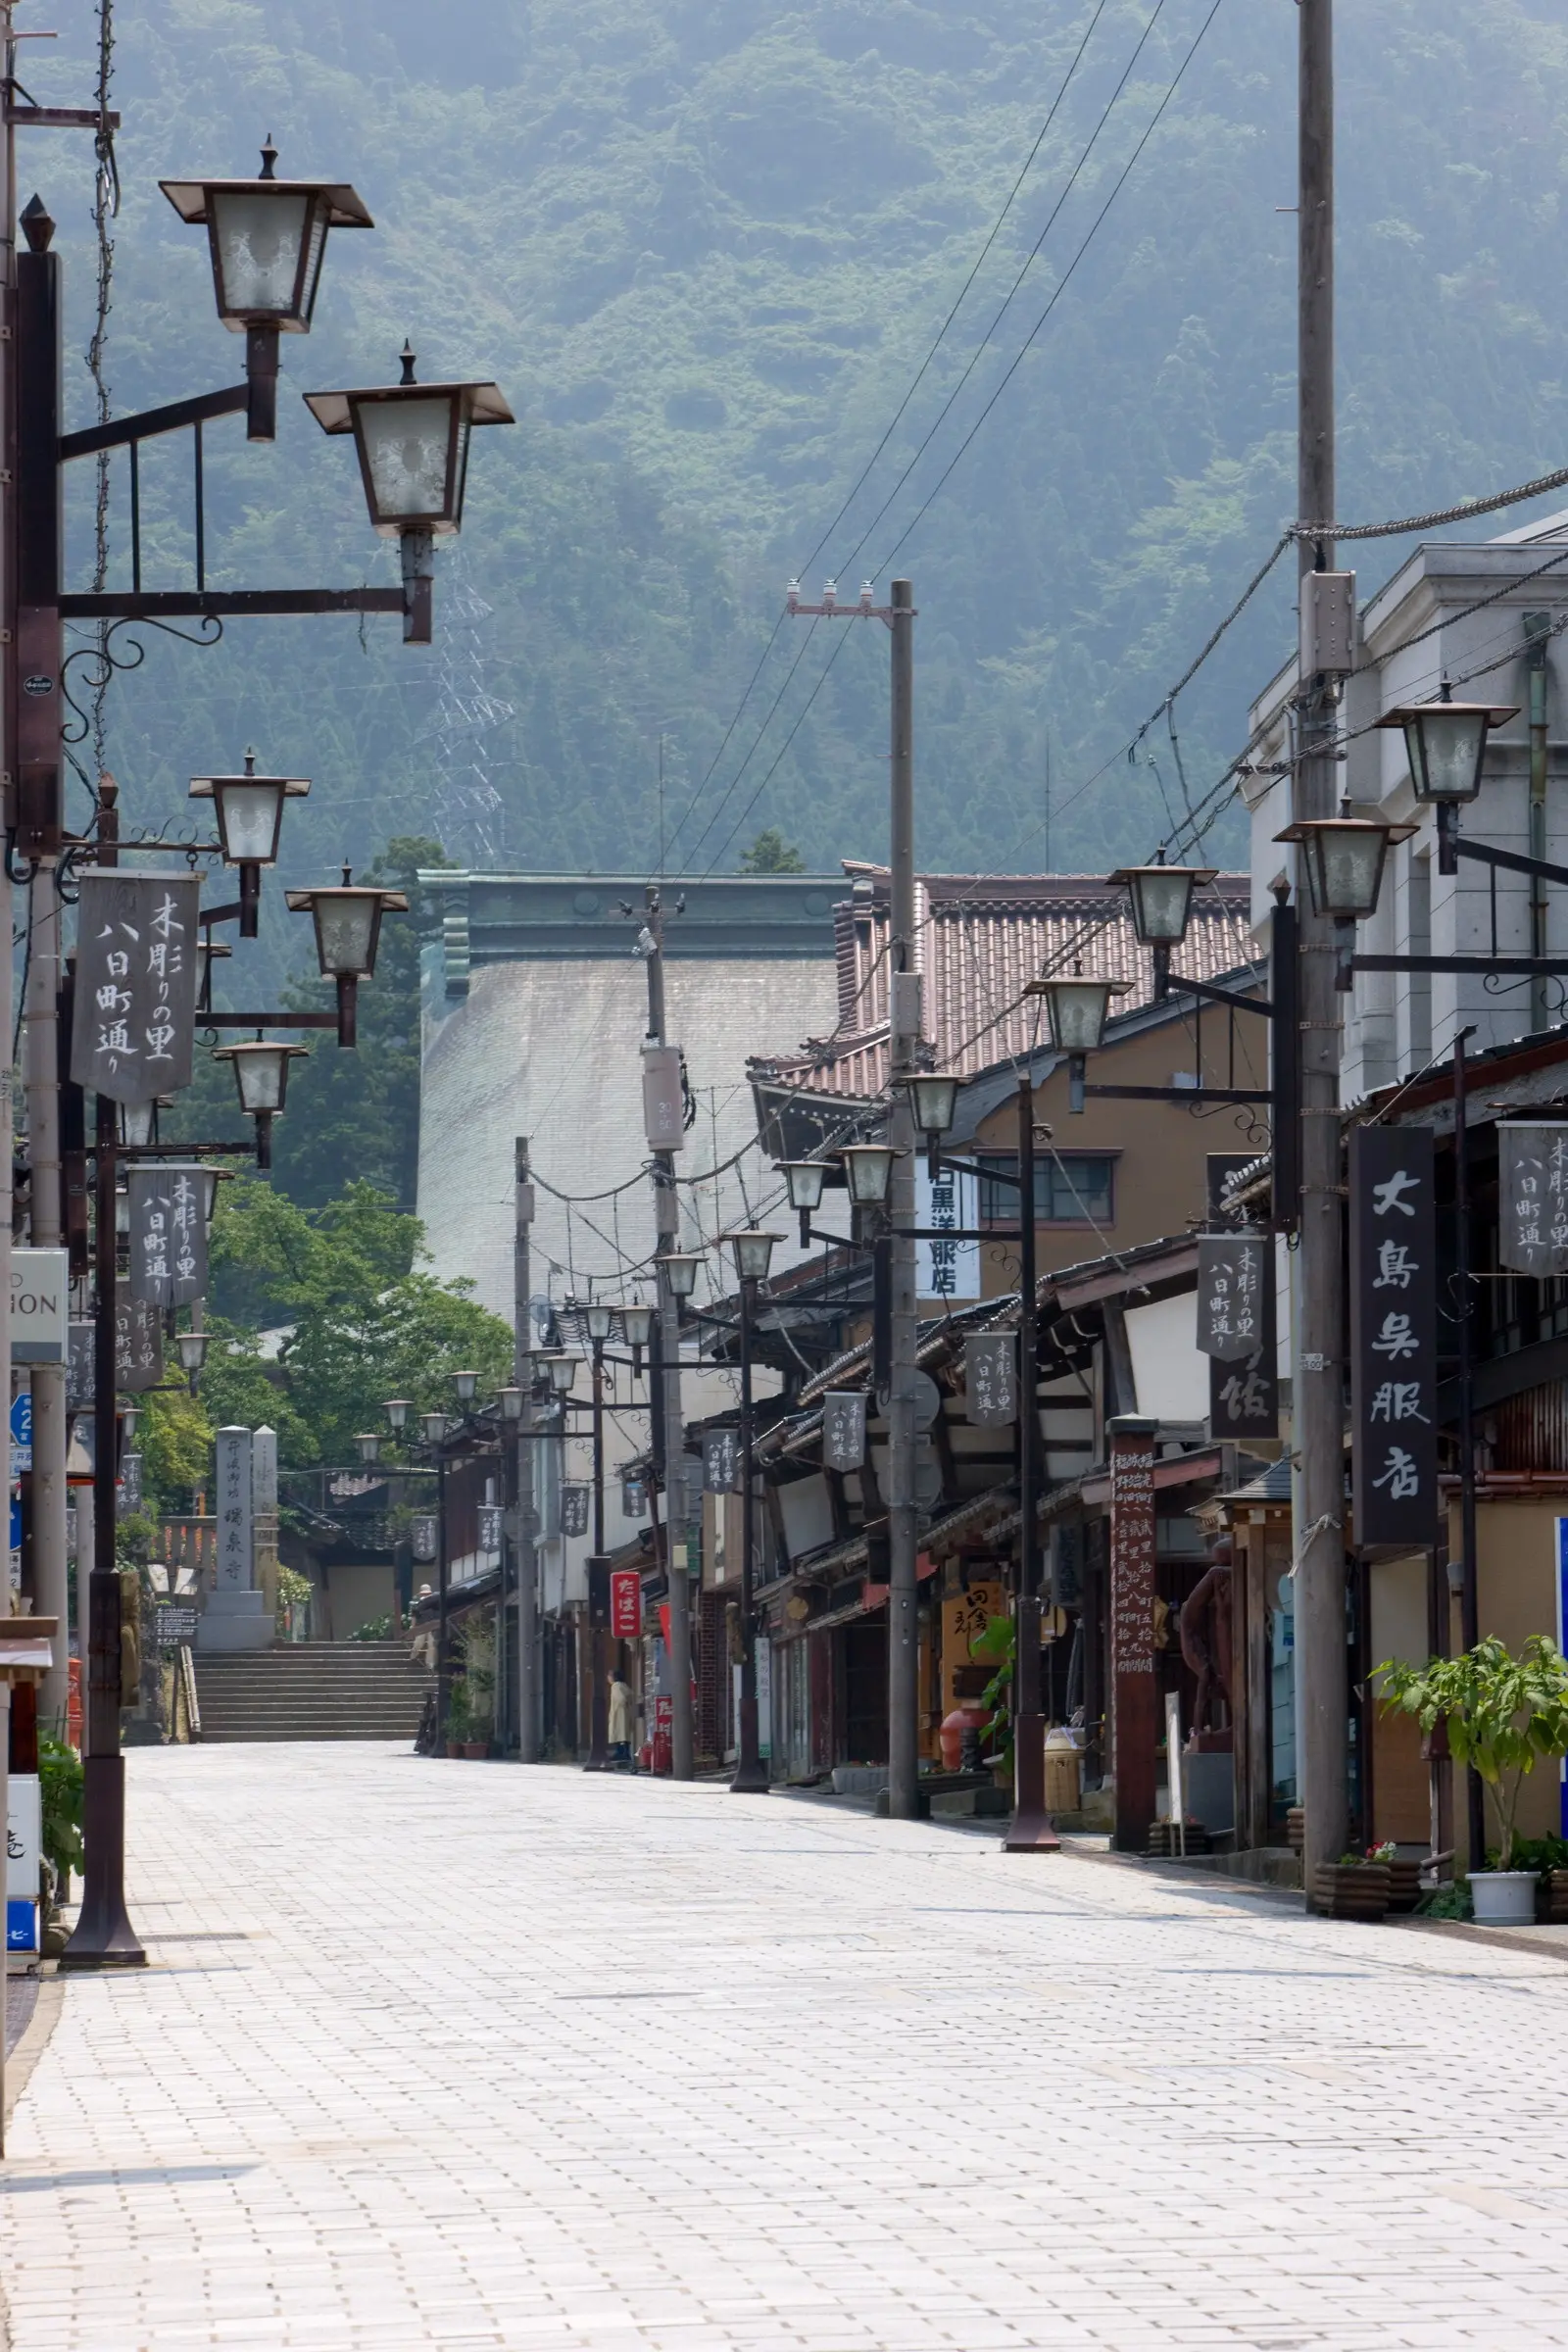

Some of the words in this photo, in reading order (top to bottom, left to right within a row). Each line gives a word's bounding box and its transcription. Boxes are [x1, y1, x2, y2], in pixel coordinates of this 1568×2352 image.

[95, 922, 140, 1064] 八日町通り
[146, 893, 185, 1060] 木彫りの里
[142, 1197, 172, 1293] 八日町通り
[172, 1175, 197, 1281] 木彫りの里
[1514, 1158, 1547, 1262] 八日町通り
[1208, 1263, 1235, 1348] 八日町通り
[1236, 1247, 1257, 1338] 木彫りの里
[1371, 1170, 1431, 1500] 大島呉服店
[975, 1354, 997, 1419] 八日町通り
[996, 1341, 1011, 1411] 木彫りの里
[618, 1579, 635, 1630] たばこ
